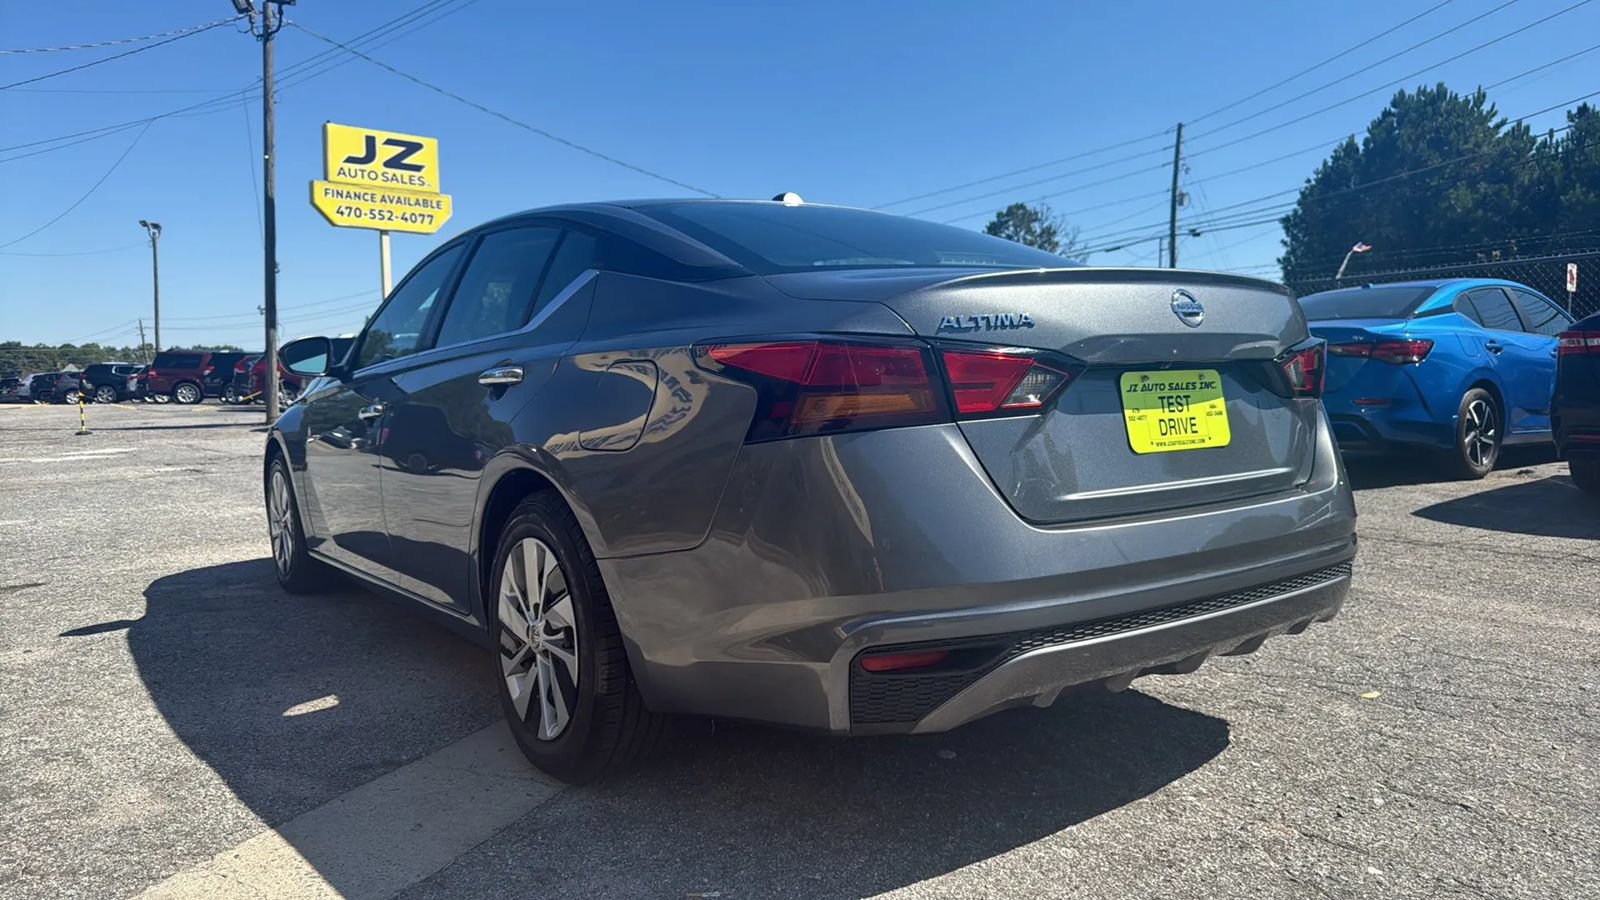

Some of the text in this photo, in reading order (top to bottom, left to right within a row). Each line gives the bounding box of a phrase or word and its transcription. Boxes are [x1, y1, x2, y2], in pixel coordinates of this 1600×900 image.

[343, 135, 425, 172] JZ
[337, 167, 425, 186] AUTO SALES
[324, 188, 443, 210] FINANCE AVAILABLE
[336, 205, 434, 225] 470-552-4077
[937, 313, 1035, 334] ALTIMA
[1126, 383, 1138, 393] JZ
[1141, 382, 1165, 392] AUTO
[1168, 381, 1197, 391] SALES
[1158, 395, 1191, 414] TEST
[1159, 417, 1198, 436] DRIVE
